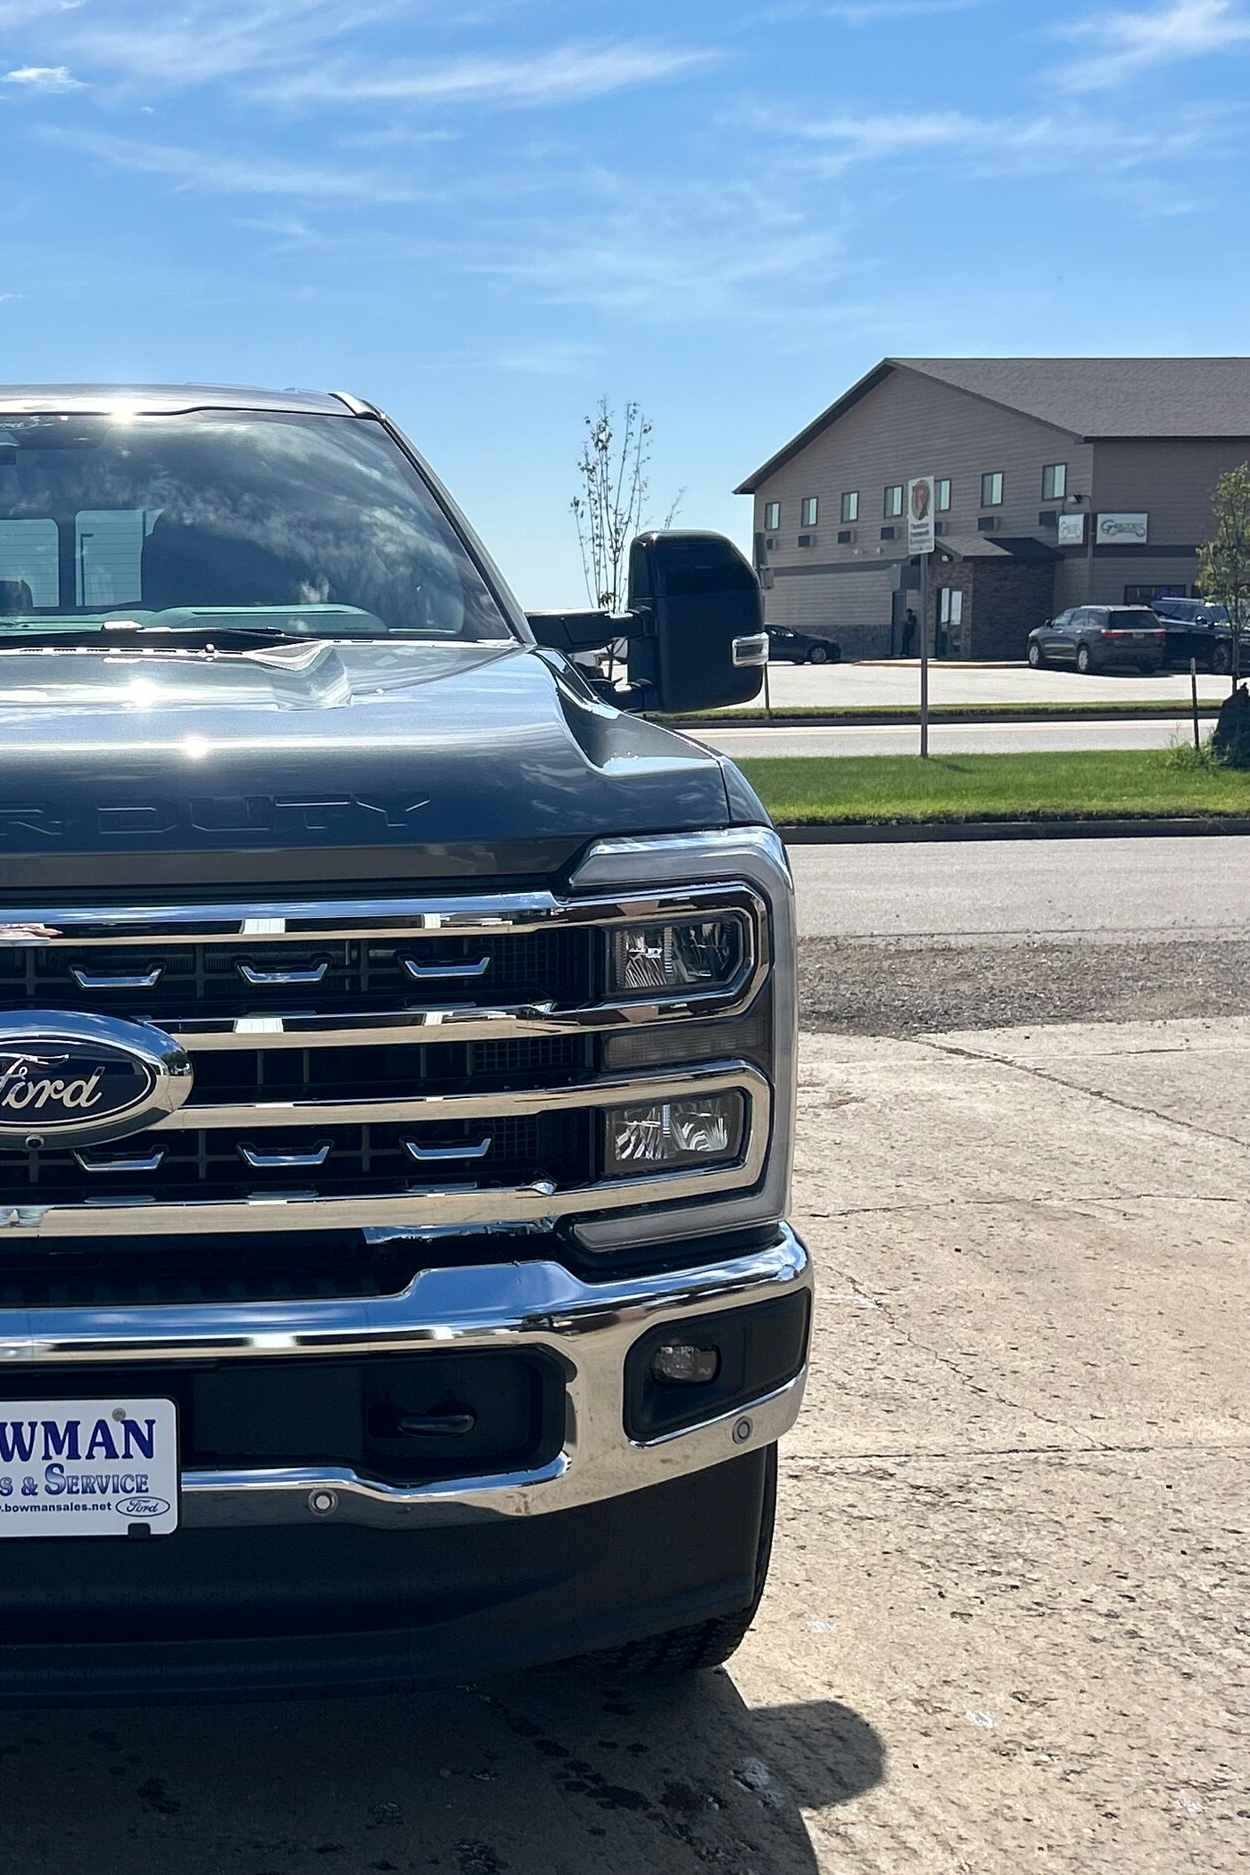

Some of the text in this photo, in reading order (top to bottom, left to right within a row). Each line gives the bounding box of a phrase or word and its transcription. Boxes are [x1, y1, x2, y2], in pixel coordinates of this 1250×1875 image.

[96, 792, 431, 837] DUTY
[21, 1476, 39, 1496] &
[126, 1499, 159, 1513] Ford
